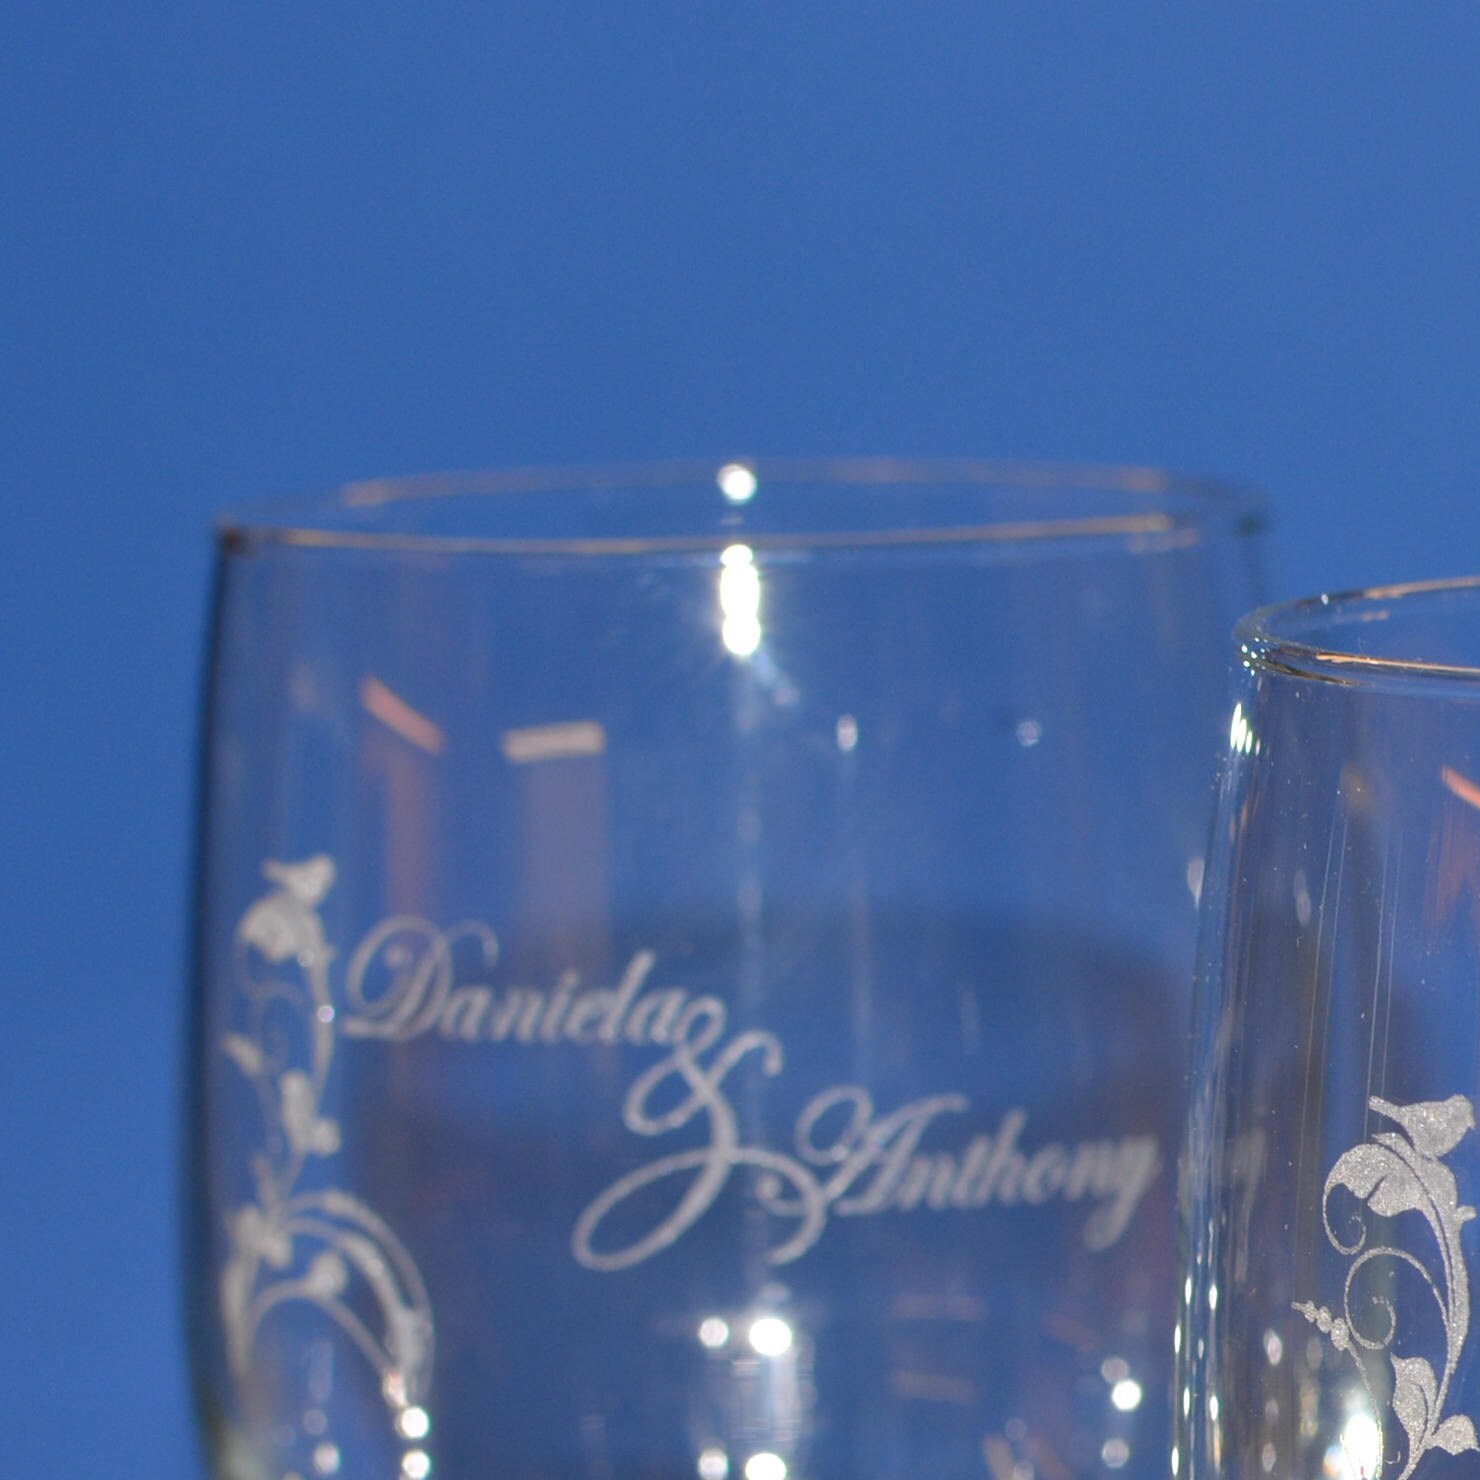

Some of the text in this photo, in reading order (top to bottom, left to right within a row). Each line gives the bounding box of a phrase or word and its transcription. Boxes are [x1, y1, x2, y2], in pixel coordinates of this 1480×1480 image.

[343, 915, 1160, 1272] Daniela & Anthony
